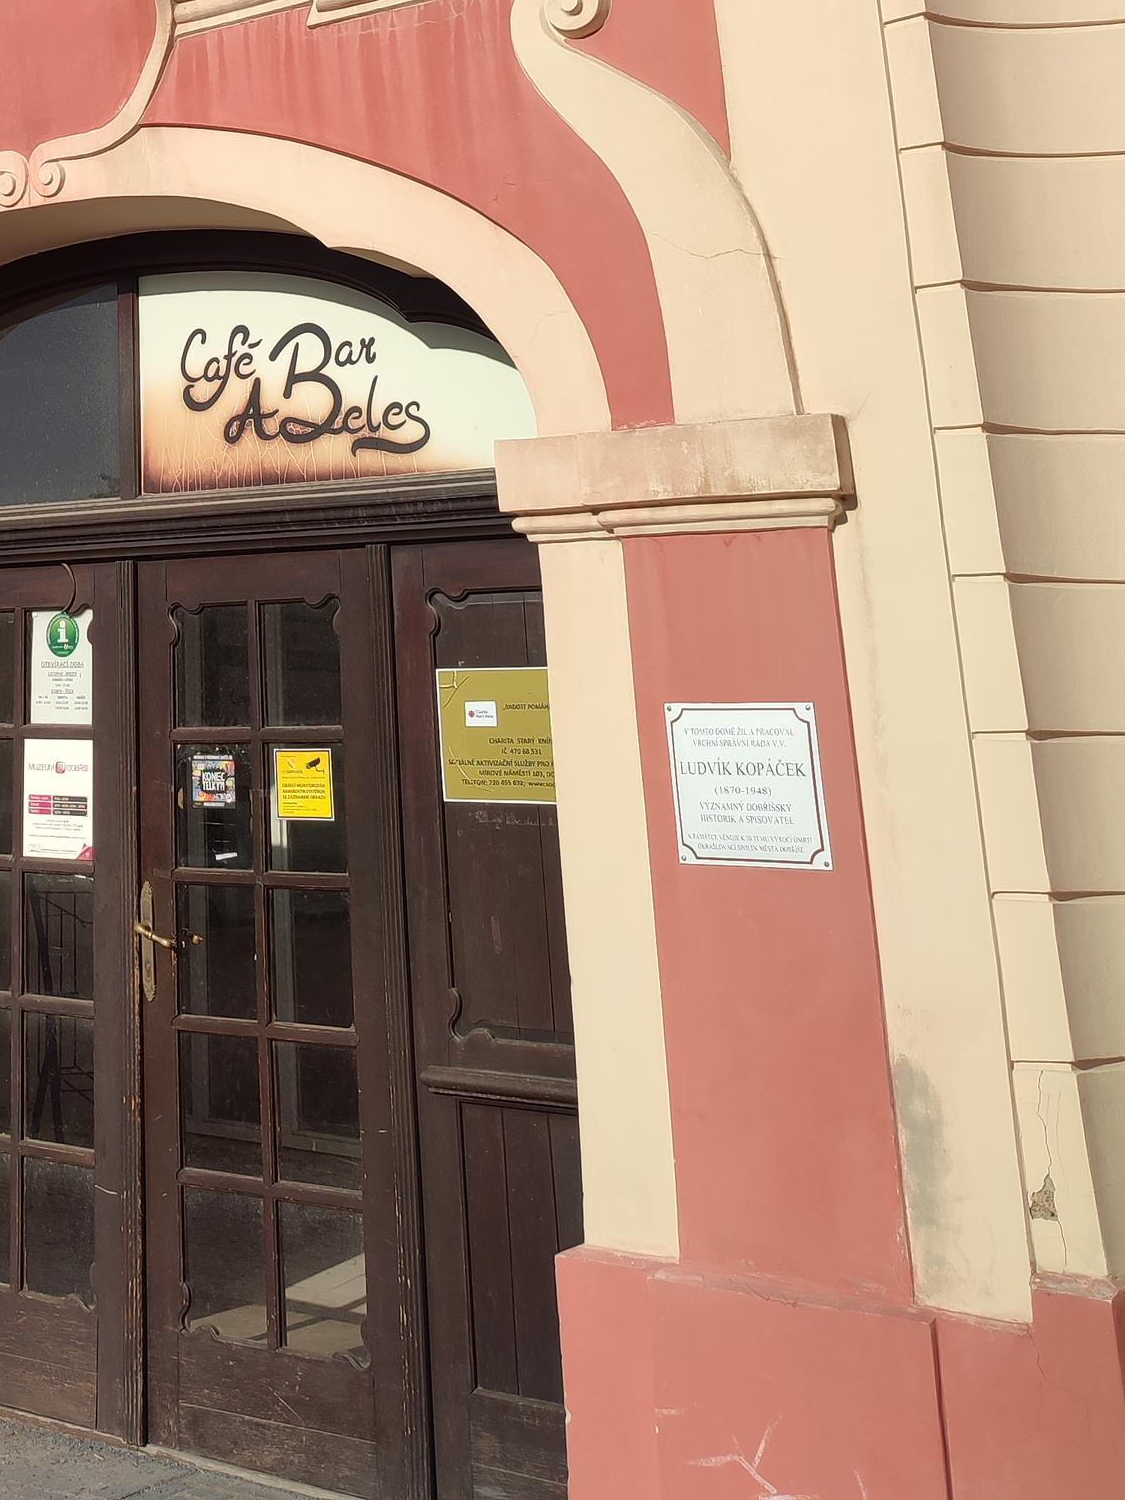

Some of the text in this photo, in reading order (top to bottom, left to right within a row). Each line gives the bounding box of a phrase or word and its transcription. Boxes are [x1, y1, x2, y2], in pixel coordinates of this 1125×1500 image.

[180, 324, 263, 412] Café
[28, 762, 55, 771] MUZEUM
[680, 757, 807, 777] LUDVÍK KOPÁČEK
[202, 771, 226, 781] KONEC
[714, 785, 772, 797] (1870-1948)
[699, 800, 744, 811] VÝZNAMNÝ
[700, 814, 795, 825] HISTORIK A SPISOVATEL
